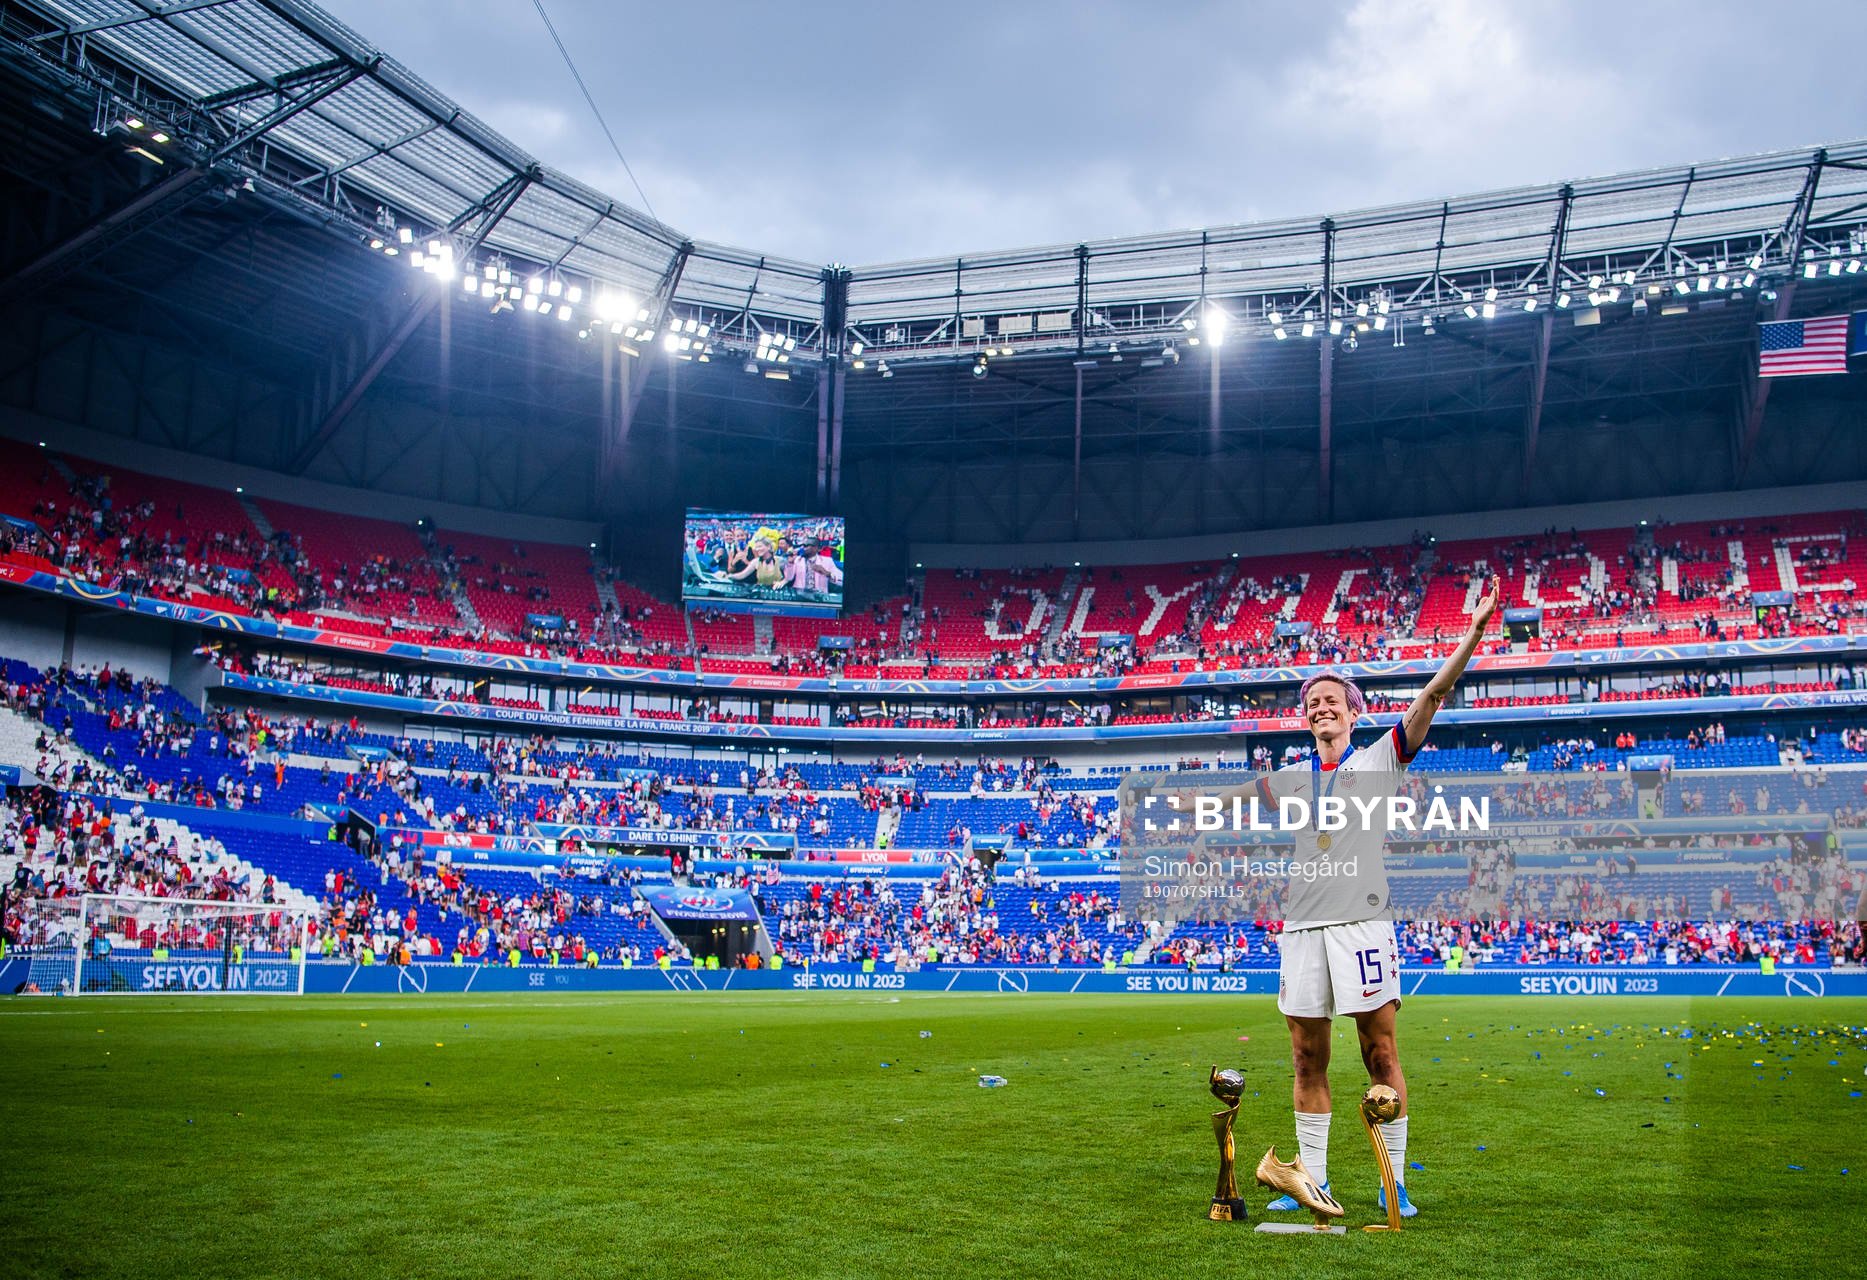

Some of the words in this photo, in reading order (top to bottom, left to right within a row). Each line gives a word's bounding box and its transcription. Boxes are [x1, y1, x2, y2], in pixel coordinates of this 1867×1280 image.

[495, 710, 525, 720] COUPE
[526, 712, 538, 721] DU
[540, 713, 571, 724] MONDE
[614, 719, 626, 728] DE
[627, 720, 638, 729] LA
[660, 723, 691, 732] FRANCE
[1280, 720, 1302, 729] LYON
[1502, 827, 1516, 836] DE
[1518, 825, 1560, 836] BRILLER
[629, 832, 654, 842] DARE
[655, 832, 668, 842] TO
[669, 833, 699, 844] SHINE
[861, 852, 888, 862] LYON
[1355, 949, 1383, 985] 15
[227, 967, 248, 989] IN
[254, 969, 288, 987] 2023
[529, 972, 545, 986] SEE
[793, 973, 818, 988] SEE
[820, 974, 851, 988] YOU
[855, 974, 869, 988] IN
[873, 974, 905, 989] 2023
[1126, 976, 1152, 991] SEE
[1155, 976, 1188, 991] YOU
[1192, 976, 1208, 991] IN
[1211, 976, 1247, 991] 2023
[1520, 976, 1550, 994] SEE
[1551, 976, 1597, 995] YOU
[1597, 976, 1617, 994] IN
[1624, 978, 1659, 993] 2023
[1212, 1205, 1230, 1214] FIFA
